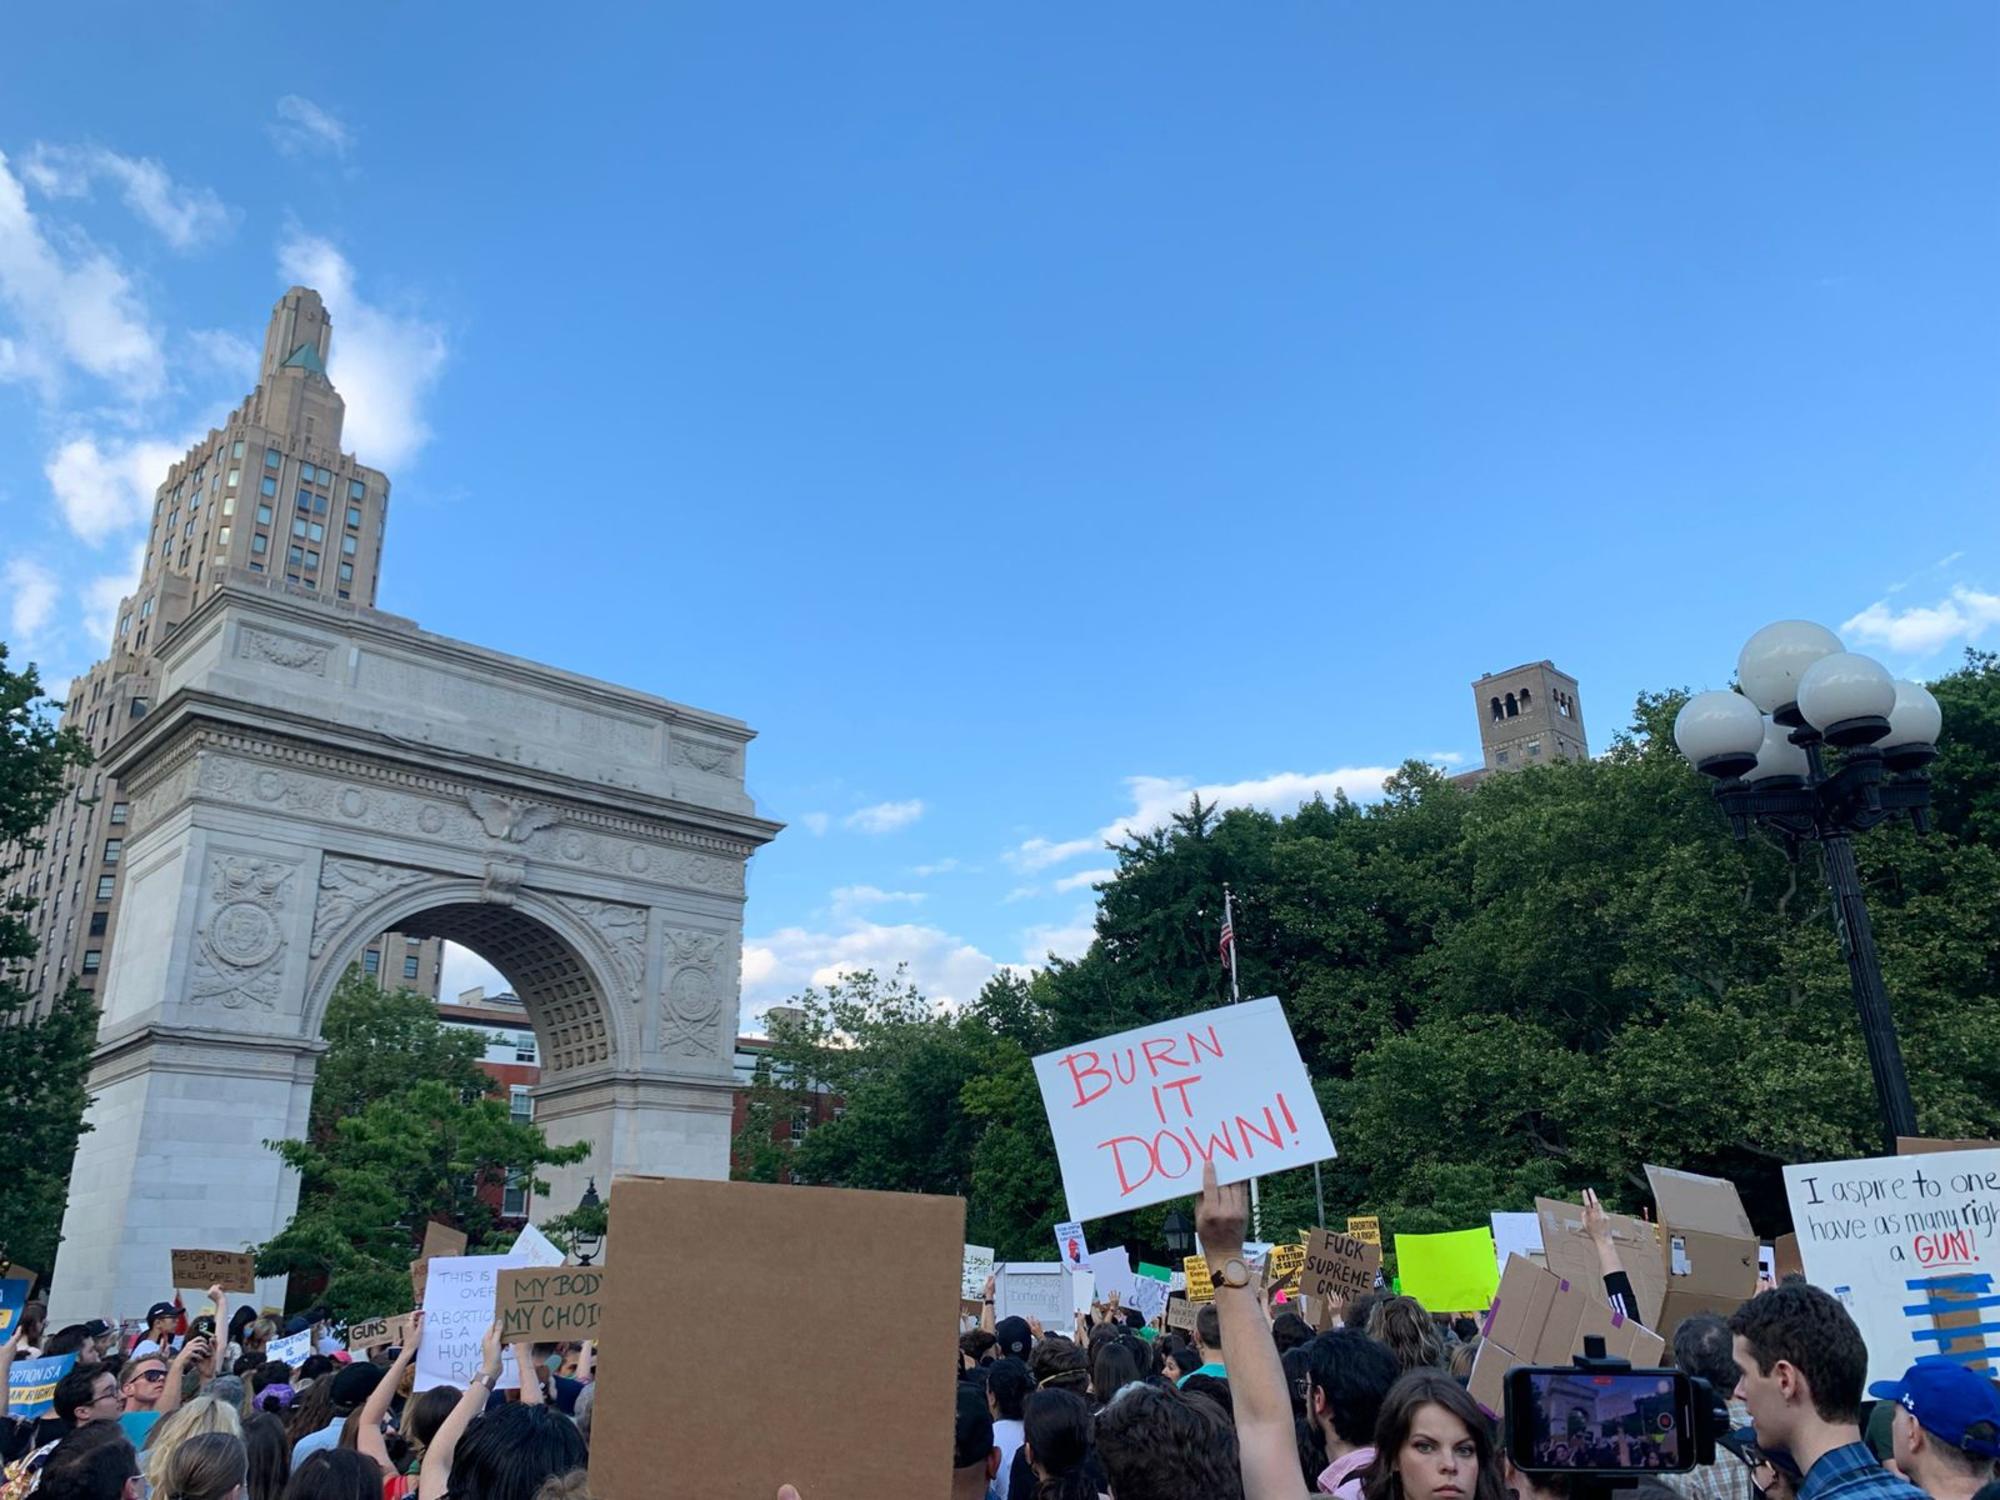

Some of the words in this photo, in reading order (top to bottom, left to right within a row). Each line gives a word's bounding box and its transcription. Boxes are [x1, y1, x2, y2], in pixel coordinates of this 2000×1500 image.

[1058, 1024, 1224, 1109] BURN
[1151, 1075, 1202, 1124] IT
[1097, 1092, 1298, 1197] DOWN!
[1801, 1177, 1824, 1205] I
[1832, 1179, 1908, 1207] aspire
[1912, 1169, 1941, 1198] to
[1808, 1214, 1867, 1241] have
[1875, 1213, 1900, 1236] as
[1904, 1208, 1962, 1238] many
[1324, 1232, 1365, 1262] FUCK
[1890, 1245, 1905, 1261] a
[1914, 1228, 1980, 1264] GUN!
[439, 1271, 474, 1285] THIS
[479, 1270, 491, 1282] IS
[1306, 1255, 1371, 1289] SUPREME
[514, 1277, 550, 1299] MY
[351, 1320, 388, 1341] GUNS
[428, 1309, 493, 1326] ABORTIO
[502, 1305, 536, 1331] MY
[542, 1302, 600, 1330] CHOI
[267, 1331, 311, 1353] ABORTION
[440, 1327, 454, 1339] IS
[458, 1326, 470, 1339] A
[438, 1342, 486, 1361] HUMA
